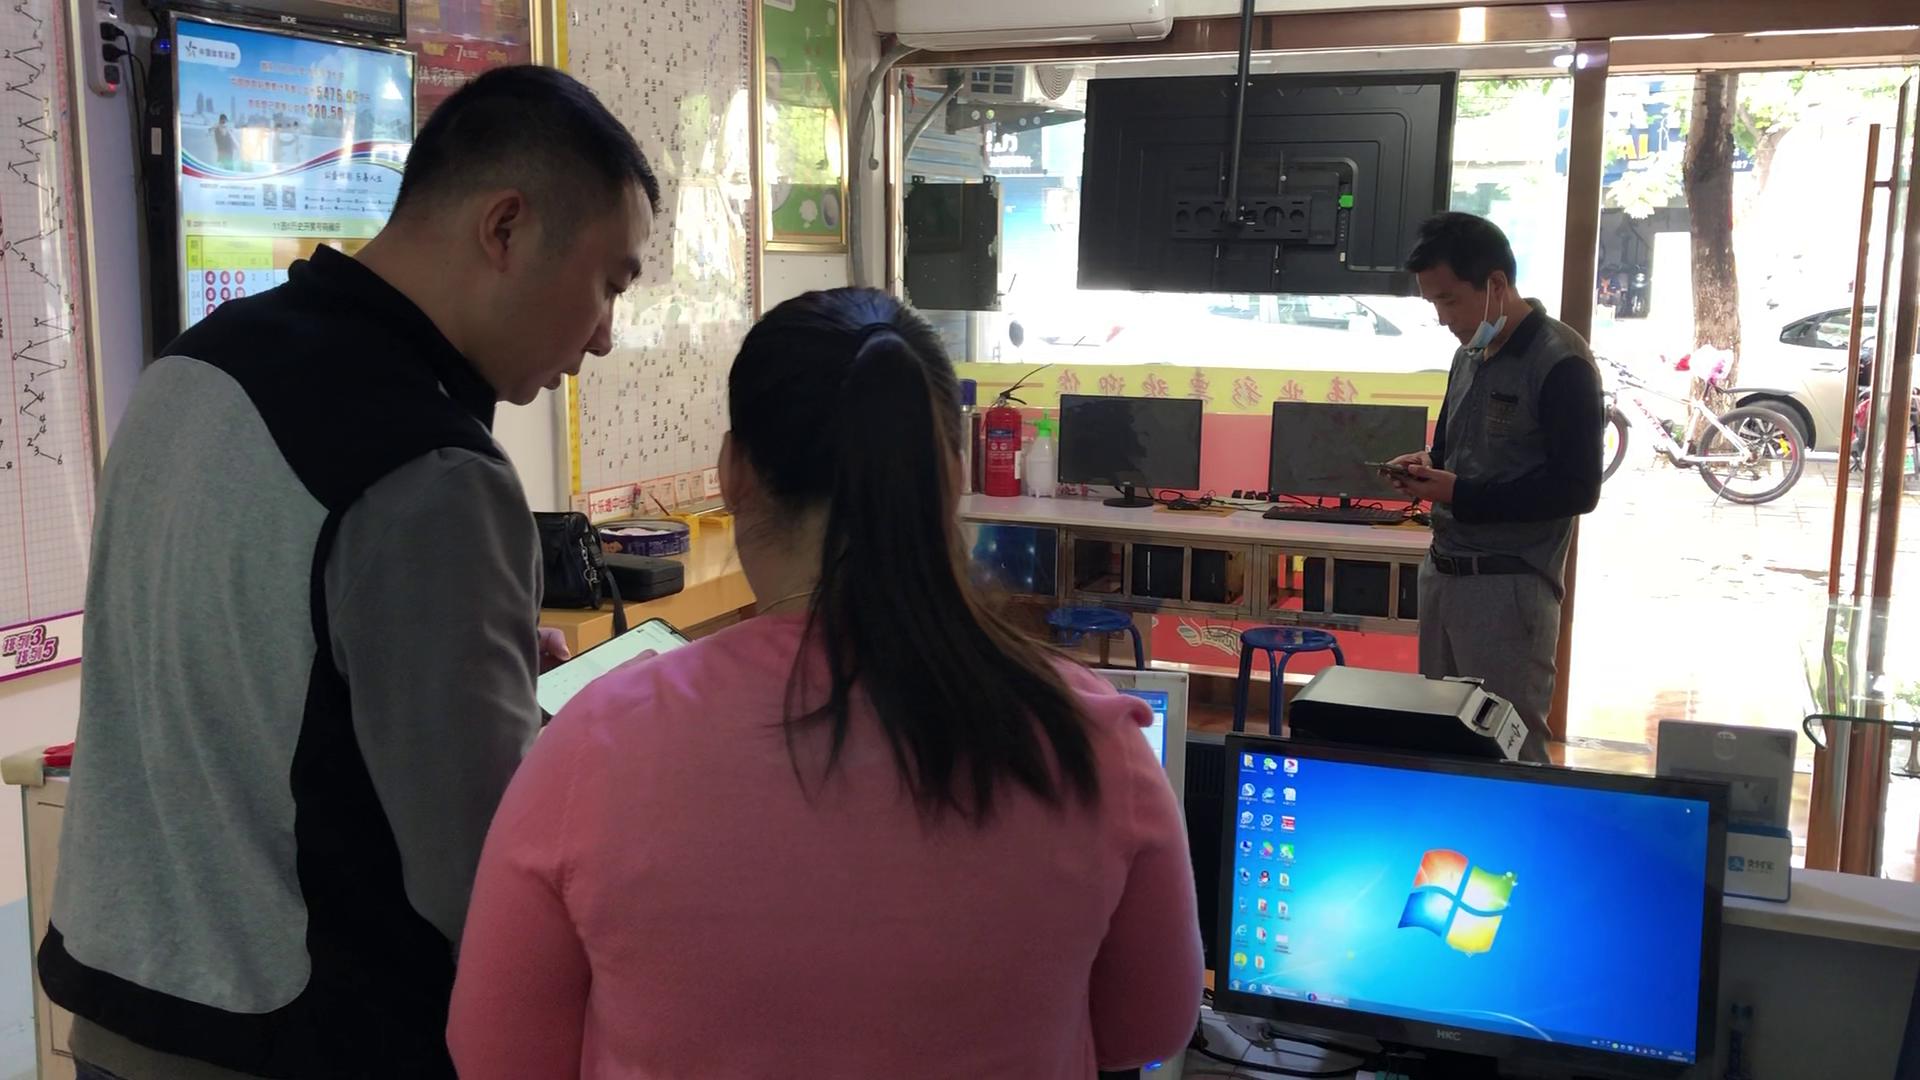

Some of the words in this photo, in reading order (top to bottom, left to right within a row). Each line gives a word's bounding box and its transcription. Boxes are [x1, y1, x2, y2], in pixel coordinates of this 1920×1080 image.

[3, 627, 44, 654] 排列3
[16, 639, 56, 666] 排列5
[1436, 1029, 1462, 1041] HKC
